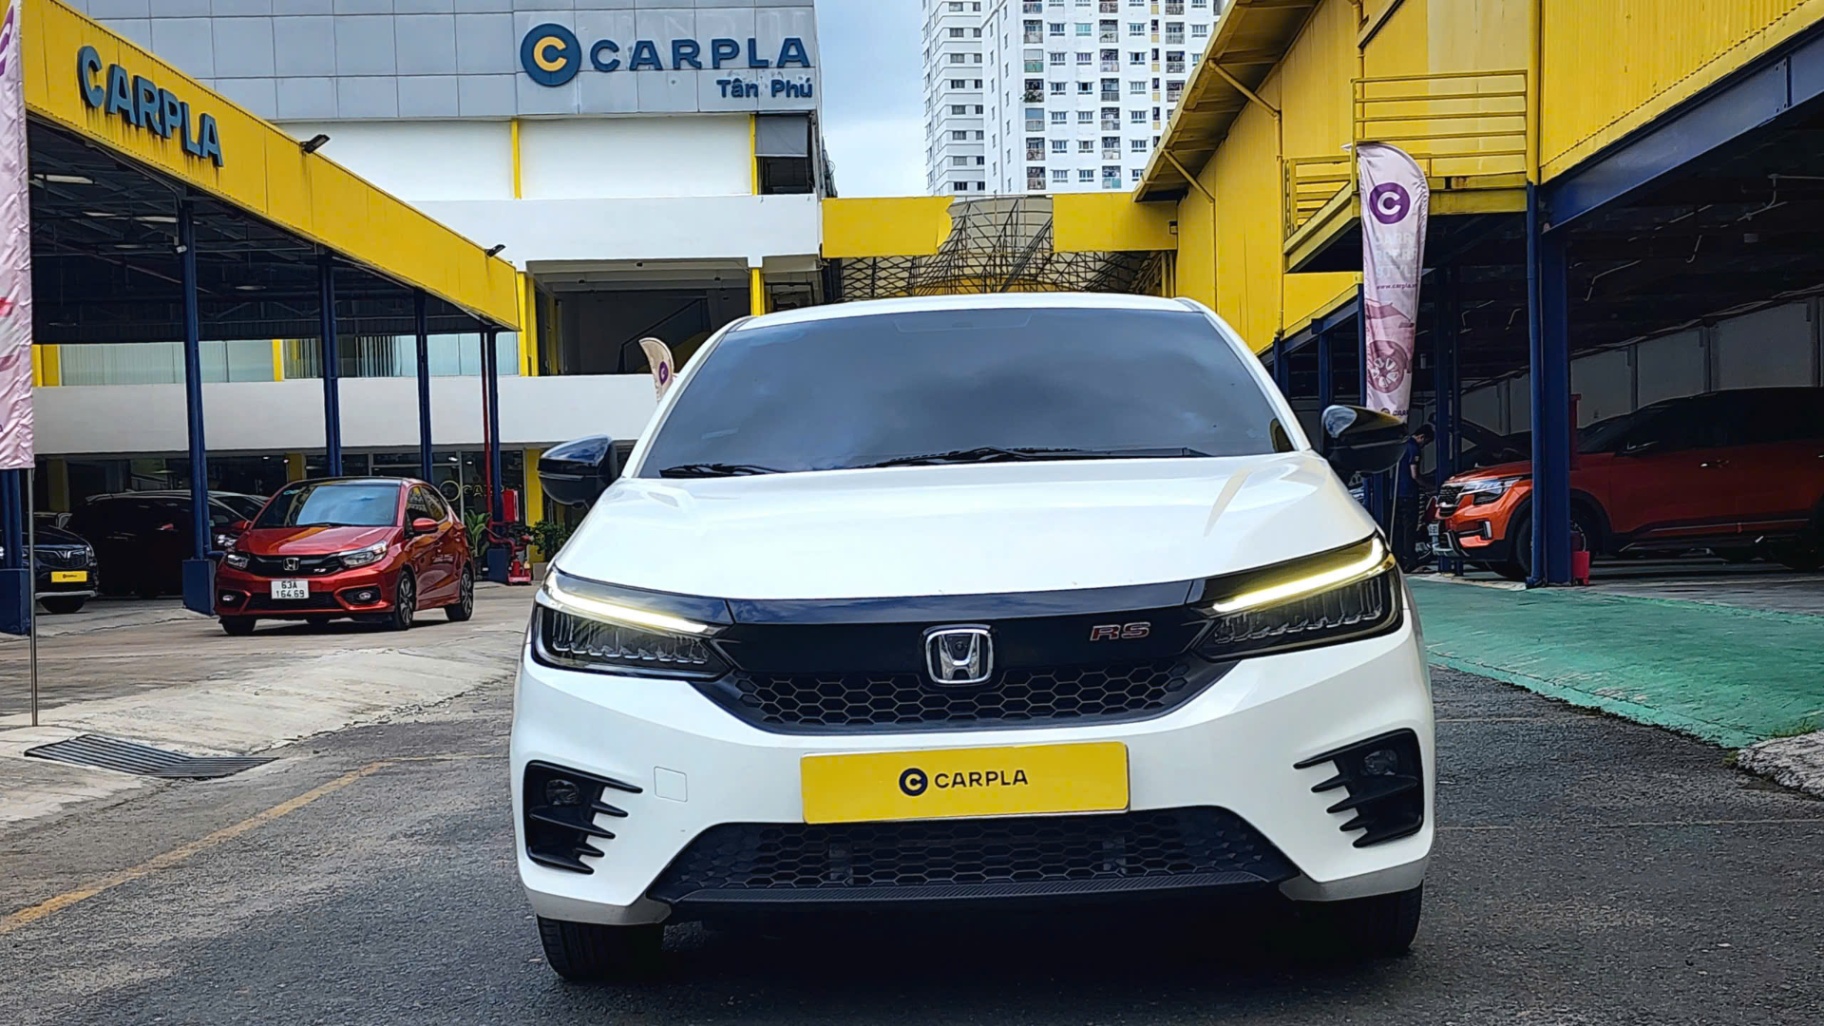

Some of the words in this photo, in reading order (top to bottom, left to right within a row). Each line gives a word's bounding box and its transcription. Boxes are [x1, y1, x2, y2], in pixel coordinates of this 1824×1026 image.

[590, 38, 811, 72] CARPLA
[716, 79, 759, 98] Tân
[770, 77, 813, 98] Phú
[77, 45, 224, 167] CARPLA
[281, 581, 298, 589] 63A
[1089, 621, 1152, 641] RS
[934, 769, 1029, 789] CARPLA
